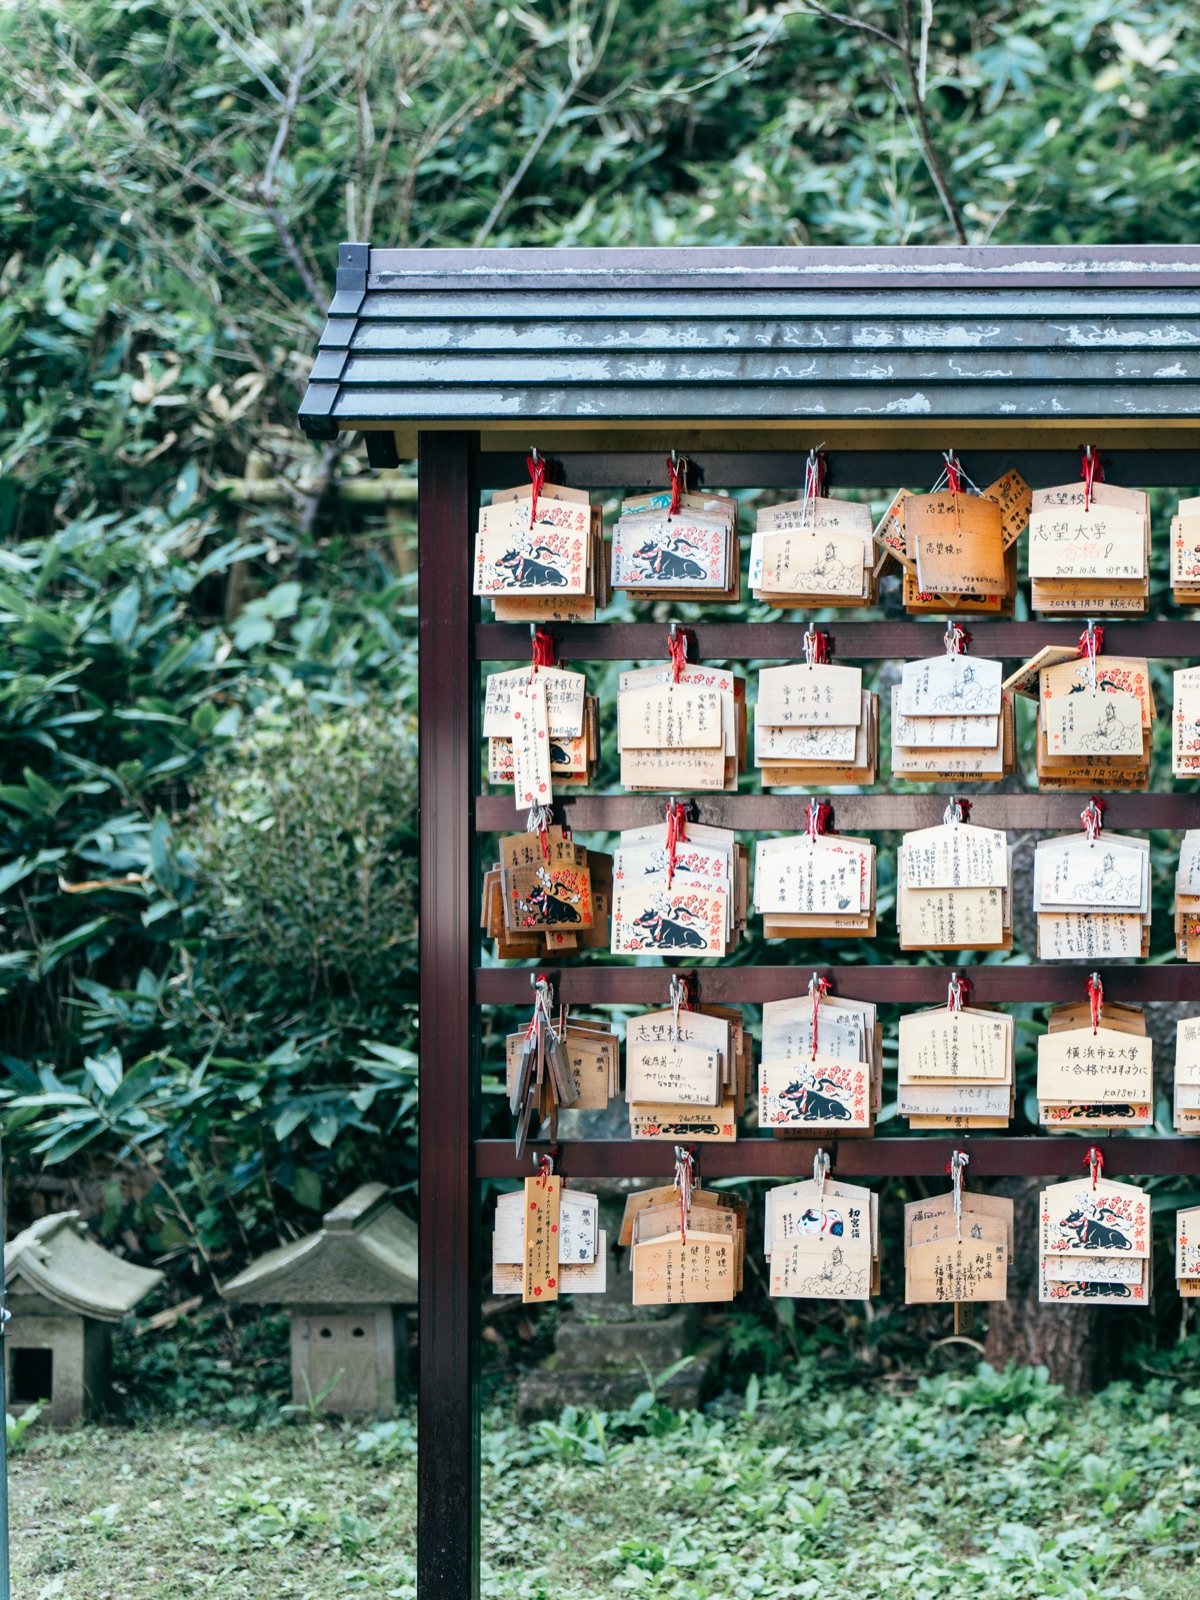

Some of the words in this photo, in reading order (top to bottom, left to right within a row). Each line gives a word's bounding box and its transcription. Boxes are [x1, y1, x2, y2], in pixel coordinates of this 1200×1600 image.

[1034, 522, 1107, 541] 志望大学
[635, 1024, 695, 1042] 志望校に
[1065, 1045, 1139, 1060] 横浜市立大学
[1060, 1063, 1148, 1075] に合格できますように
[1134, 1202, 1146, 1252] 合格祈願
